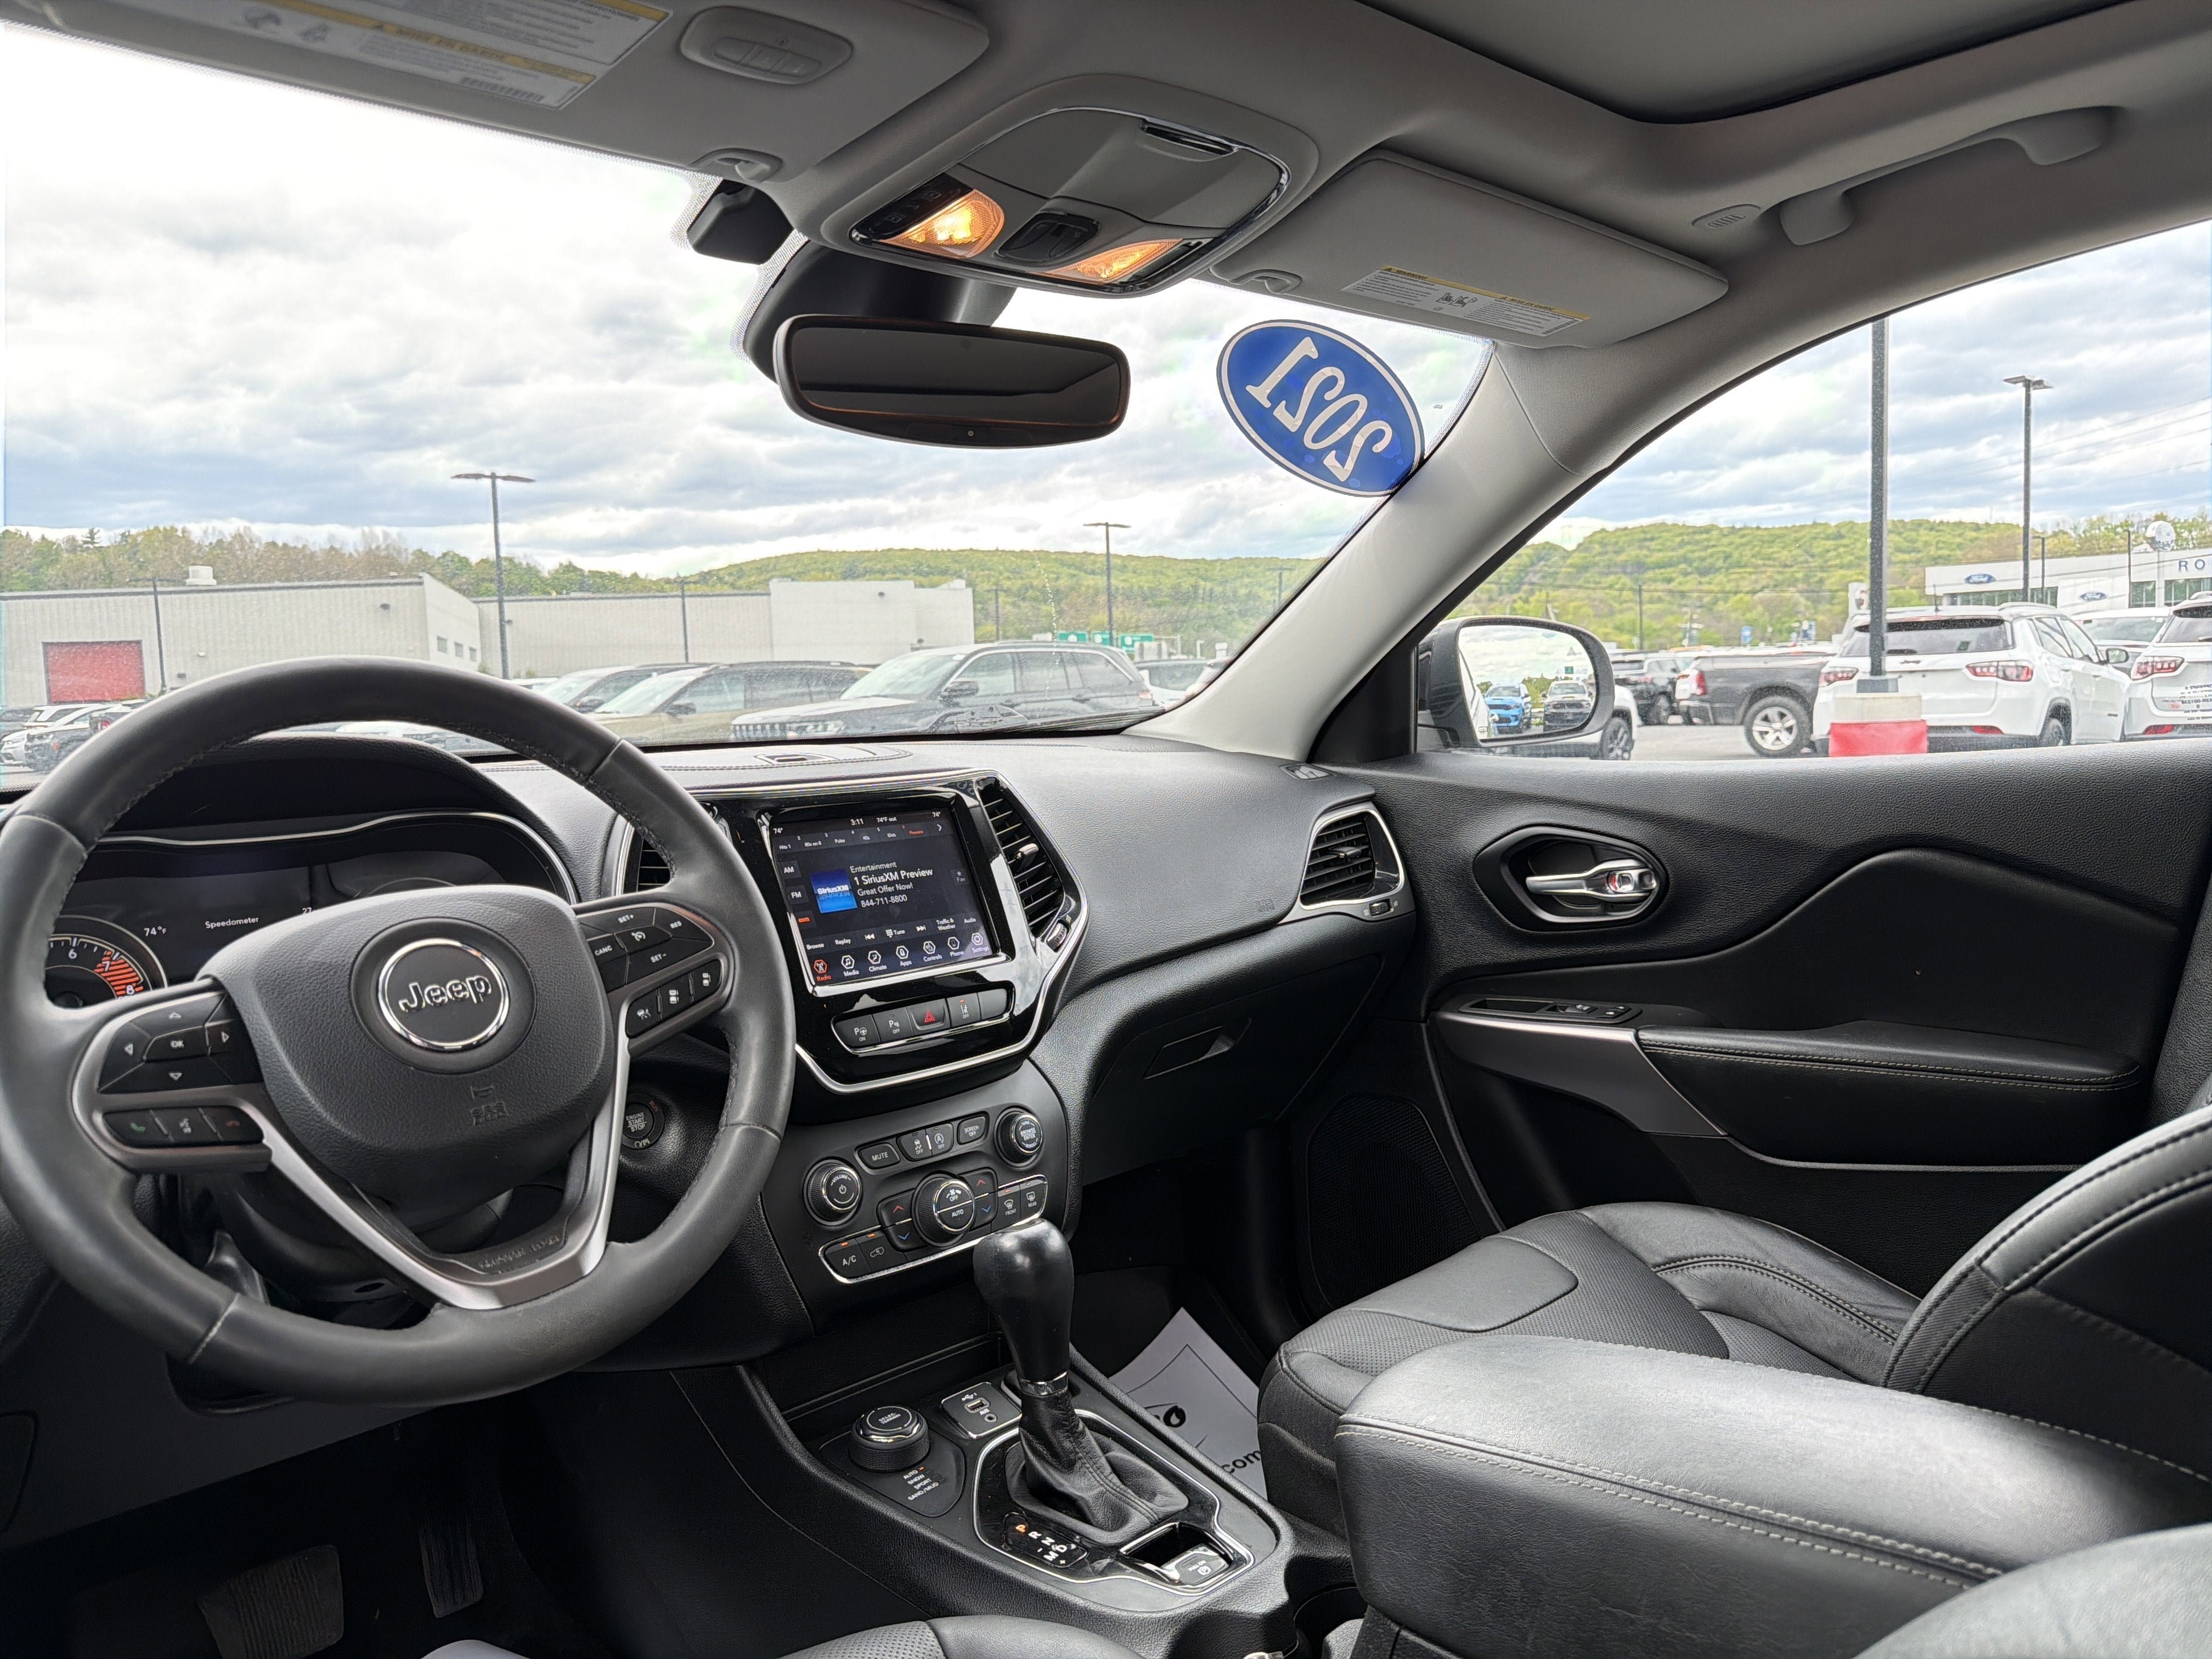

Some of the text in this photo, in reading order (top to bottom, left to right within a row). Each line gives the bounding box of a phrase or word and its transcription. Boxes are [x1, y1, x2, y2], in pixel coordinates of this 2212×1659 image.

[850, 861, 898, 874] Entertainment
[854, 869, 933, 885] 1 SiriusXM Preview
[817, 884, 849, 895] SiriusXM
[857, 883, 913, 896] Great Offer Now!
[861, 894, 908, 908] 844-711-8800
[205, 917, 259, 929] Speedometer
[670, 921, 682, 929] RES
[938, 923, 956, 931] Weather
[144, 926, 167, 936] 74°F
[68, 949, 77, 959] 6
[595, 945, 613, 956] CANC
[972, 946, 990, 954] Settings
[923, 954, 943, 962] Controls
[101, 961, 110, 972] 7
[126, 985, 134, 995] 8
[398, 974, 492, 1013] Jeep
[170, 1040, 184, 1048] OK
[649, 1100, 659, 1112] RUN
[626, 1112, 645, 1121] ENGINE
[628, 1117, 645, 1126] START
[630, 1124, 645, 1132] STOP
[964, 1125, 979, 1134] SCREEN
[872, 1152, 889, 1161] MUTE
[832, 1175, 848, 1183] VOLUME
[951, 1209, 964, 1217] AUTO
[842, 1255, 856, 1266] A/C
[904, 1469, 918, 1479] AUTO
[907, 1474, 925, 1485] SNOW
[913, 1478, 932, 1489] SPORT
[907, 1482, 939, 1500] SAND/MUD
[1015, 1524, 1026, 1532] P
[1041, 1537, 1055, 1545] N
[1055, 1544, 1067, 1553] D
[1043, 1551, 1059, 1561] M
